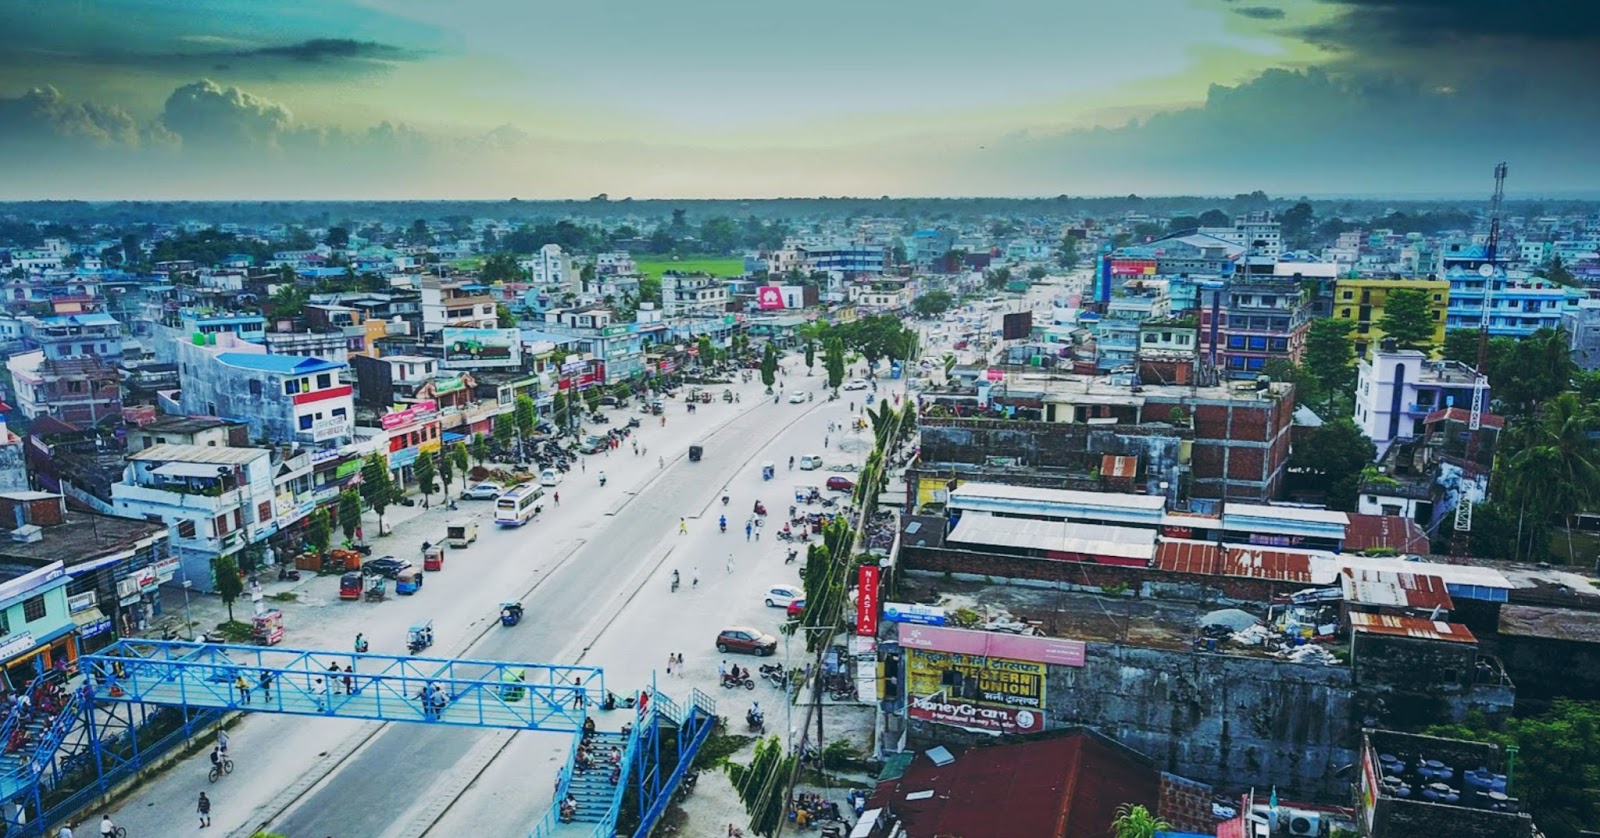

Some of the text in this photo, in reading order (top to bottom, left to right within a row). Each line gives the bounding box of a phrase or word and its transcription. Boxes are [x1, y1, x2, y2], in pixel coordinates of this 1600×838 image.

[864, 570, 872, 591] NIC
[863, 593, 871, 622] ASIA
[955, 665, 1031, 684] WESTERN
[979, 680, 1030, 696] UNION
